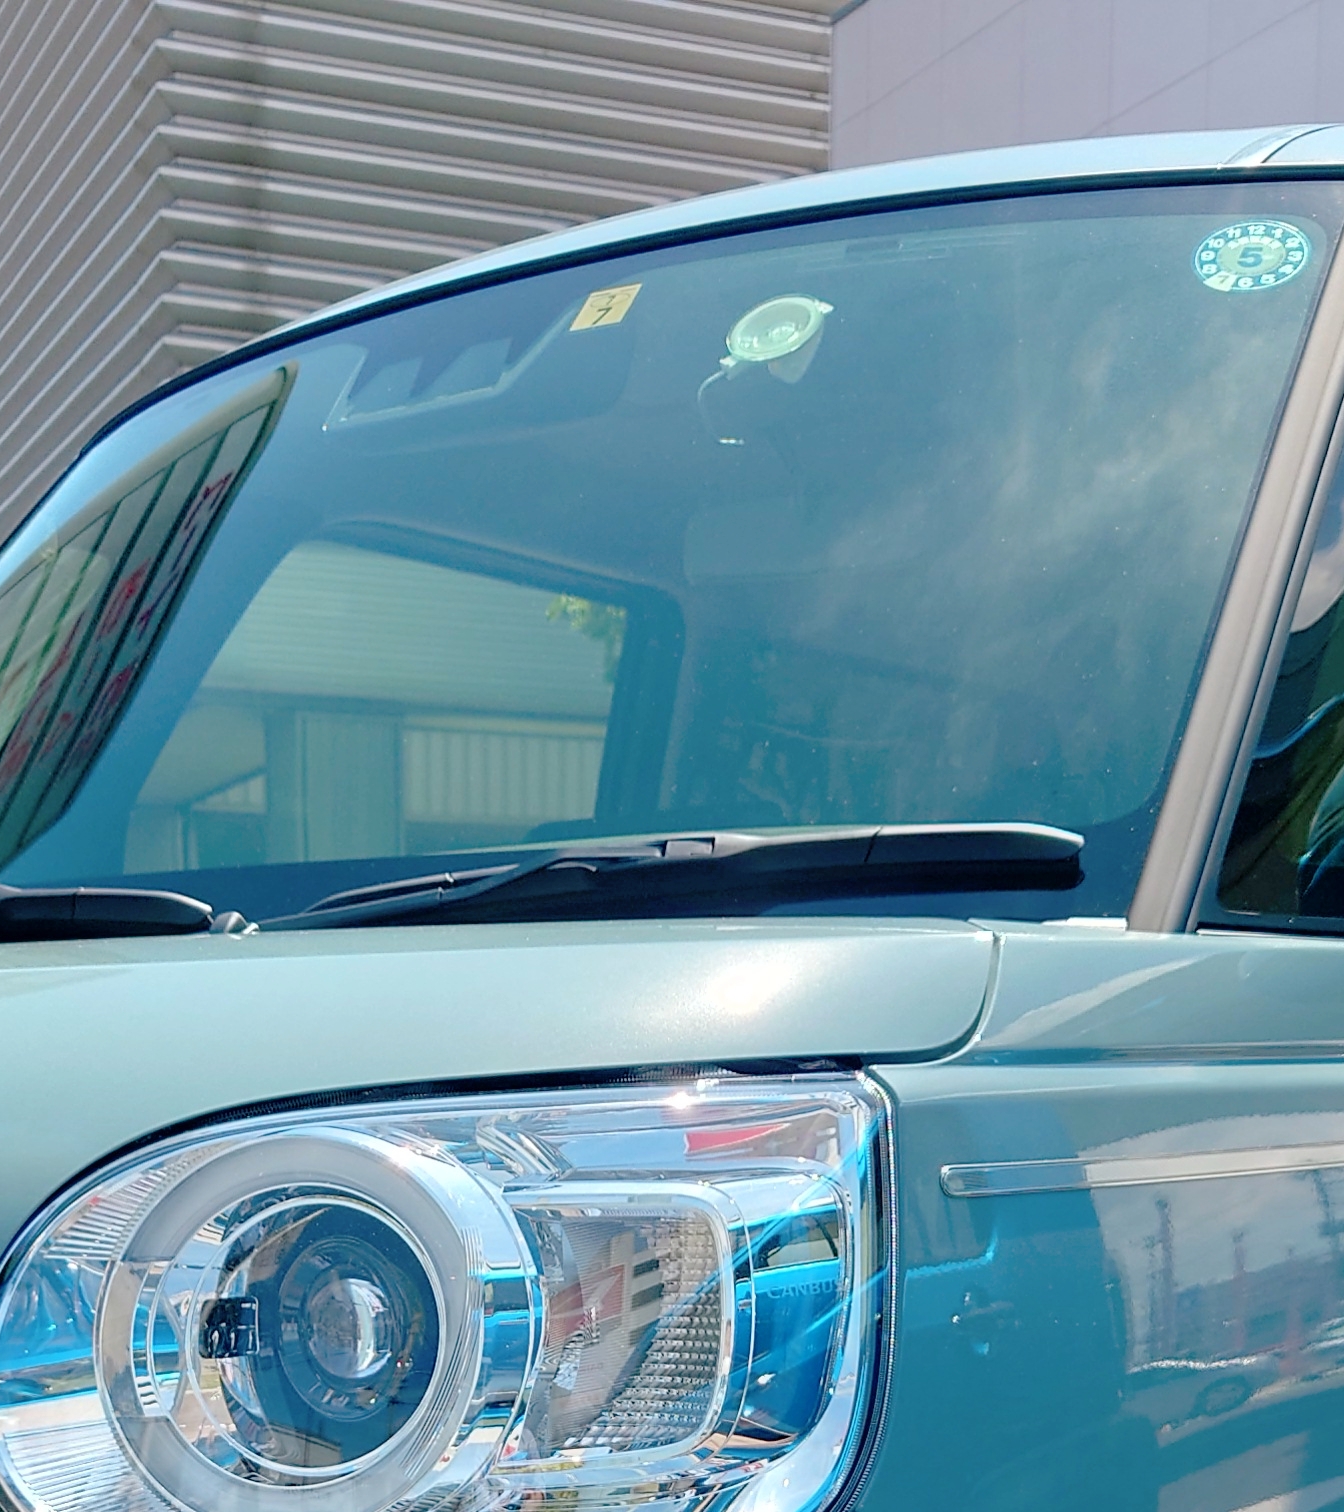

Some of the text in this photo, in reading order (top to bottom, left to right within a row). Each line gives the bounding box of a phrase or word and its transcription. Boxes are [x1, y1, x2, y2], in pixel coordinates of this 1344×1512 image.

[1247, 225, 1266, 235] 12
[1200, 250, 1216, 261] 9
[1237, 247, 1263, 268] 5
[1287, 250, 1303, 261] 3
[1238, 277, 1254, 288] 6
[592, 306, 613, 325] 7
